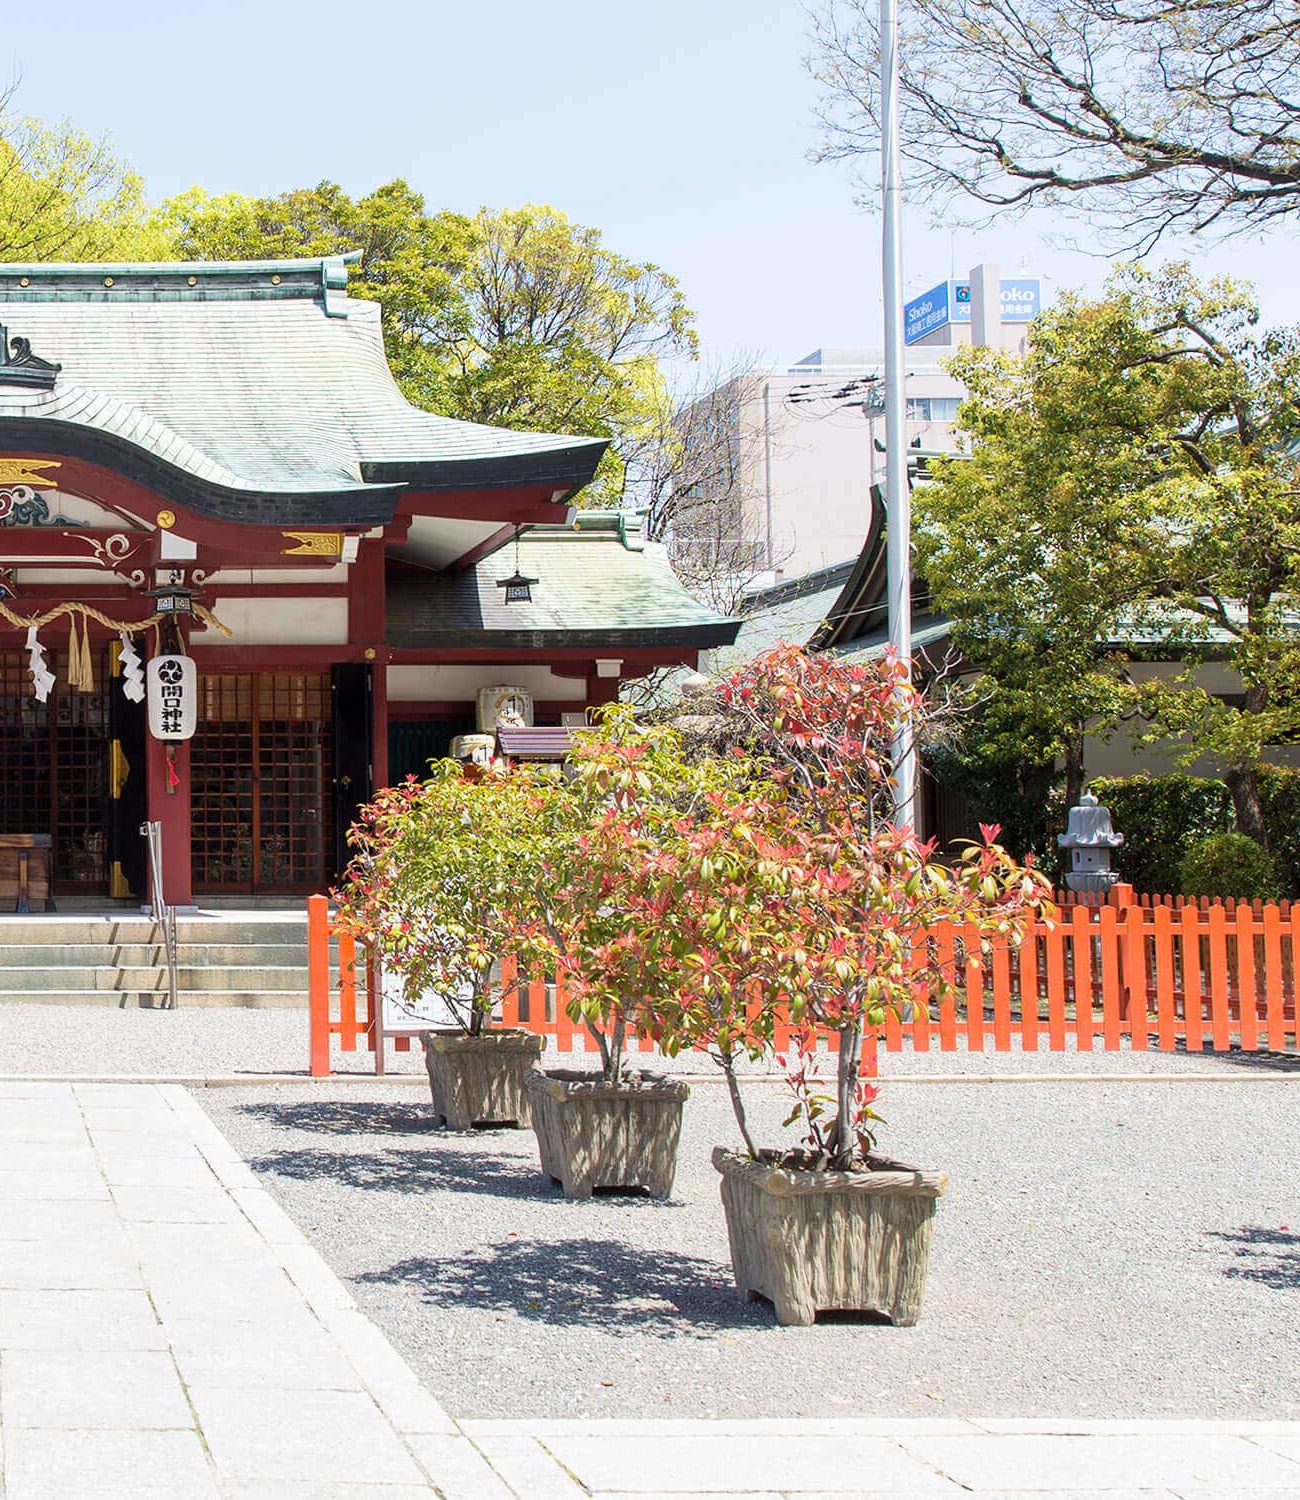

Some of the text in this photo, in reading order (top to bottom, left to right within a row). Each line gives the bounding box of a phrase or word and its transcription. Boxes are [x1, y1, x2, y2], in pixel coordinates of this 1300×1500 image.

[1000, 287, 1035, 302] oko
[161, 685, 183, 733] 開口神社
